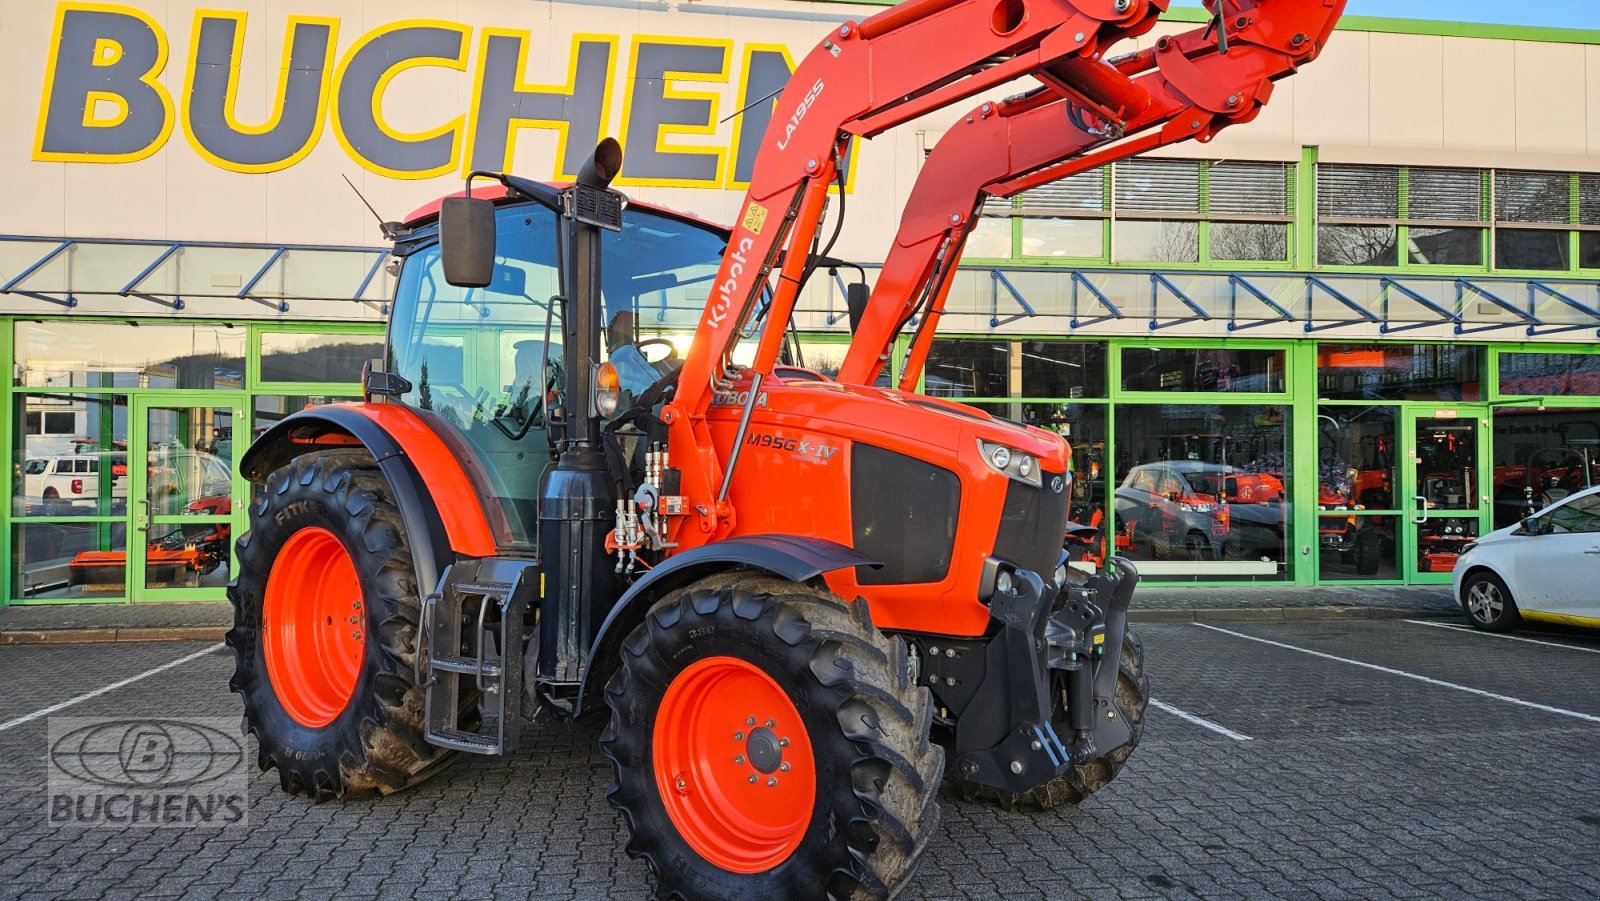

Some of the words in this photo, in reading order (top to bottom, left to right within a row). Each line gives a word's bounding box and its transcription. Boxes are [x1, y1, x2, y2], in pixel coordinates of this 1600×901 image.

[777, 77, 824, 151] LA1955
[706, 237, 753, 329] Kubota
[711, 391, 768, 407] UBOA
